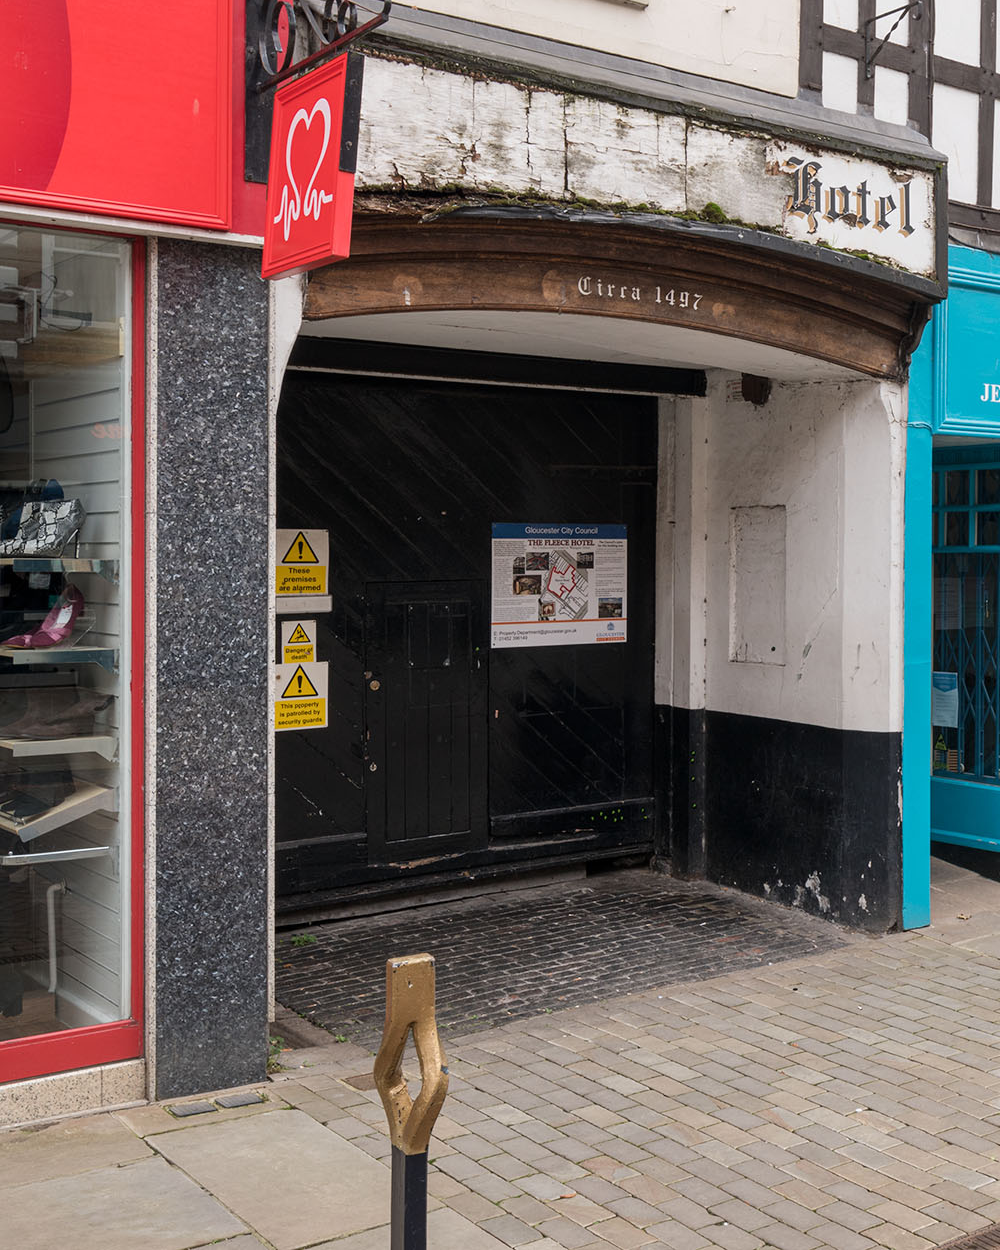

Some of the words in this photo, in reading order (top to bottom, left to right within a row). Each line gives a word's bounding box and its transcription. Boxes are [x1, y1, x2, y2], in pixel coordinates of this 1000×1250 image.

[779, 155, 916, 238] Hotel
[577, 276, 641, 301] Circa
[655, 286, 703, 310] 1497
[525, 526, 560, 535] Gloucester
[561, 526, 573, 535] City
[575, 527, 598, 535] Council
[528, 539, 543, 547] THE
[544, 539, 570, 547] FLEECE
[571, 539, 595, 547] HOTEL
[288, 567, 311, 575] These
[283, 576, 317, 584] premises
[279, 584, 291, 592] are
[285, 647, 305, 655] Danger
[305, 646, 313, 654] of
[285, 710, 312, 719] patrolled
[312, 709, 321, 717] by
[277, 718, 301, 727] security
[301, 717, 323, 726] guards
